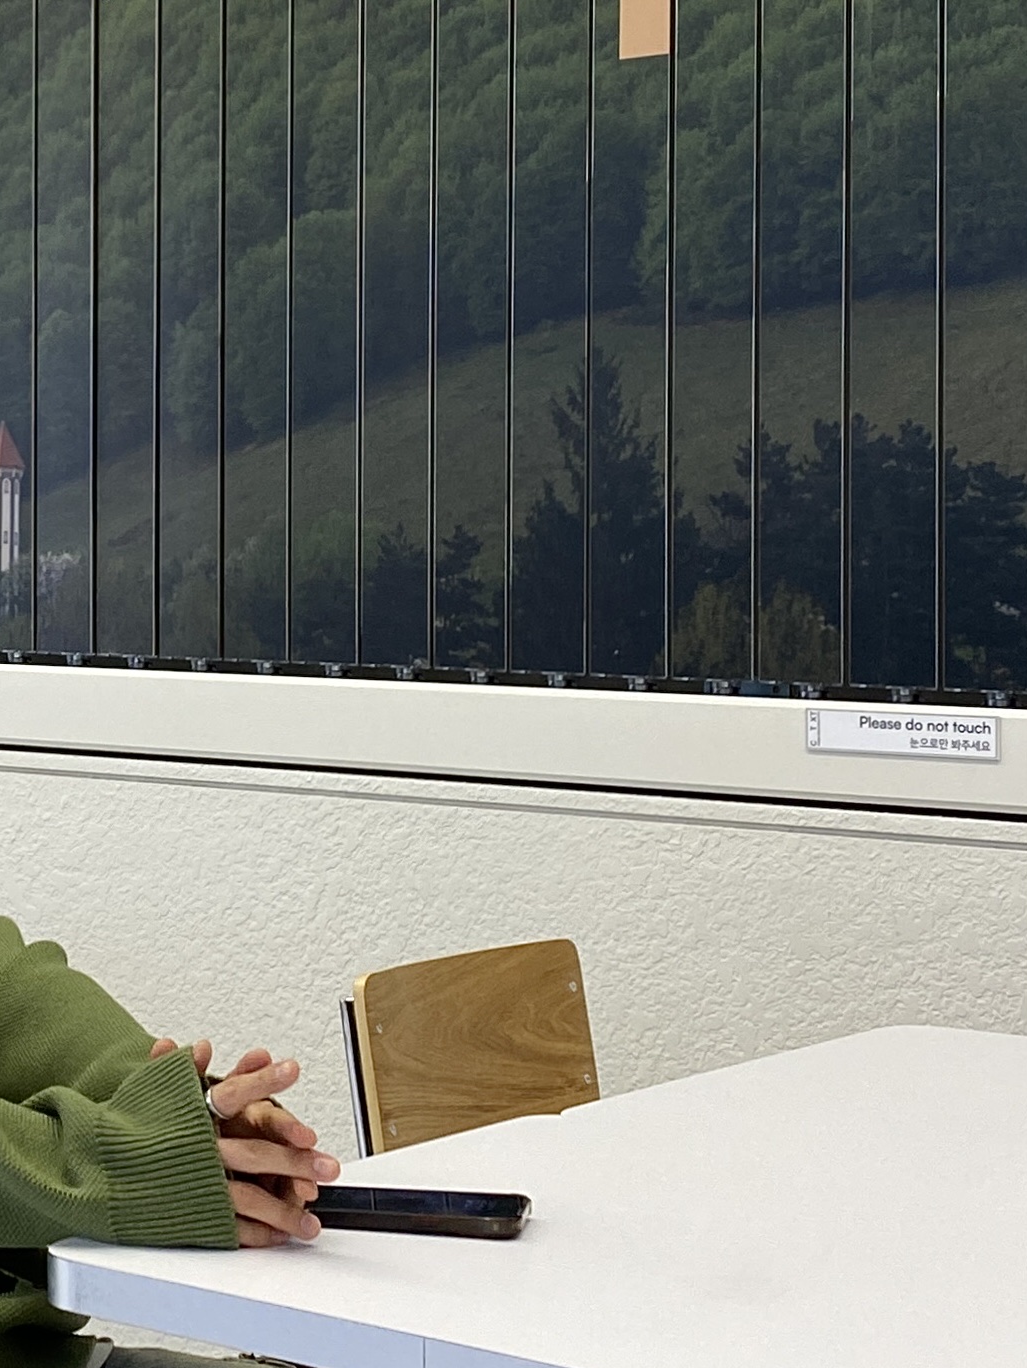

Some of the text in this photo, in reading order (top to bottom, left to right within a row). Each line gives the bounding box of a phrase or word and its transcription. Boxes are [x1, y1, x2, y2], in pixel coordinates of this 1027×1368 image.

[859, 716, 991, 734] Please do not touch
[910, 737, 991, 751] 눈으로만 봐주세요
